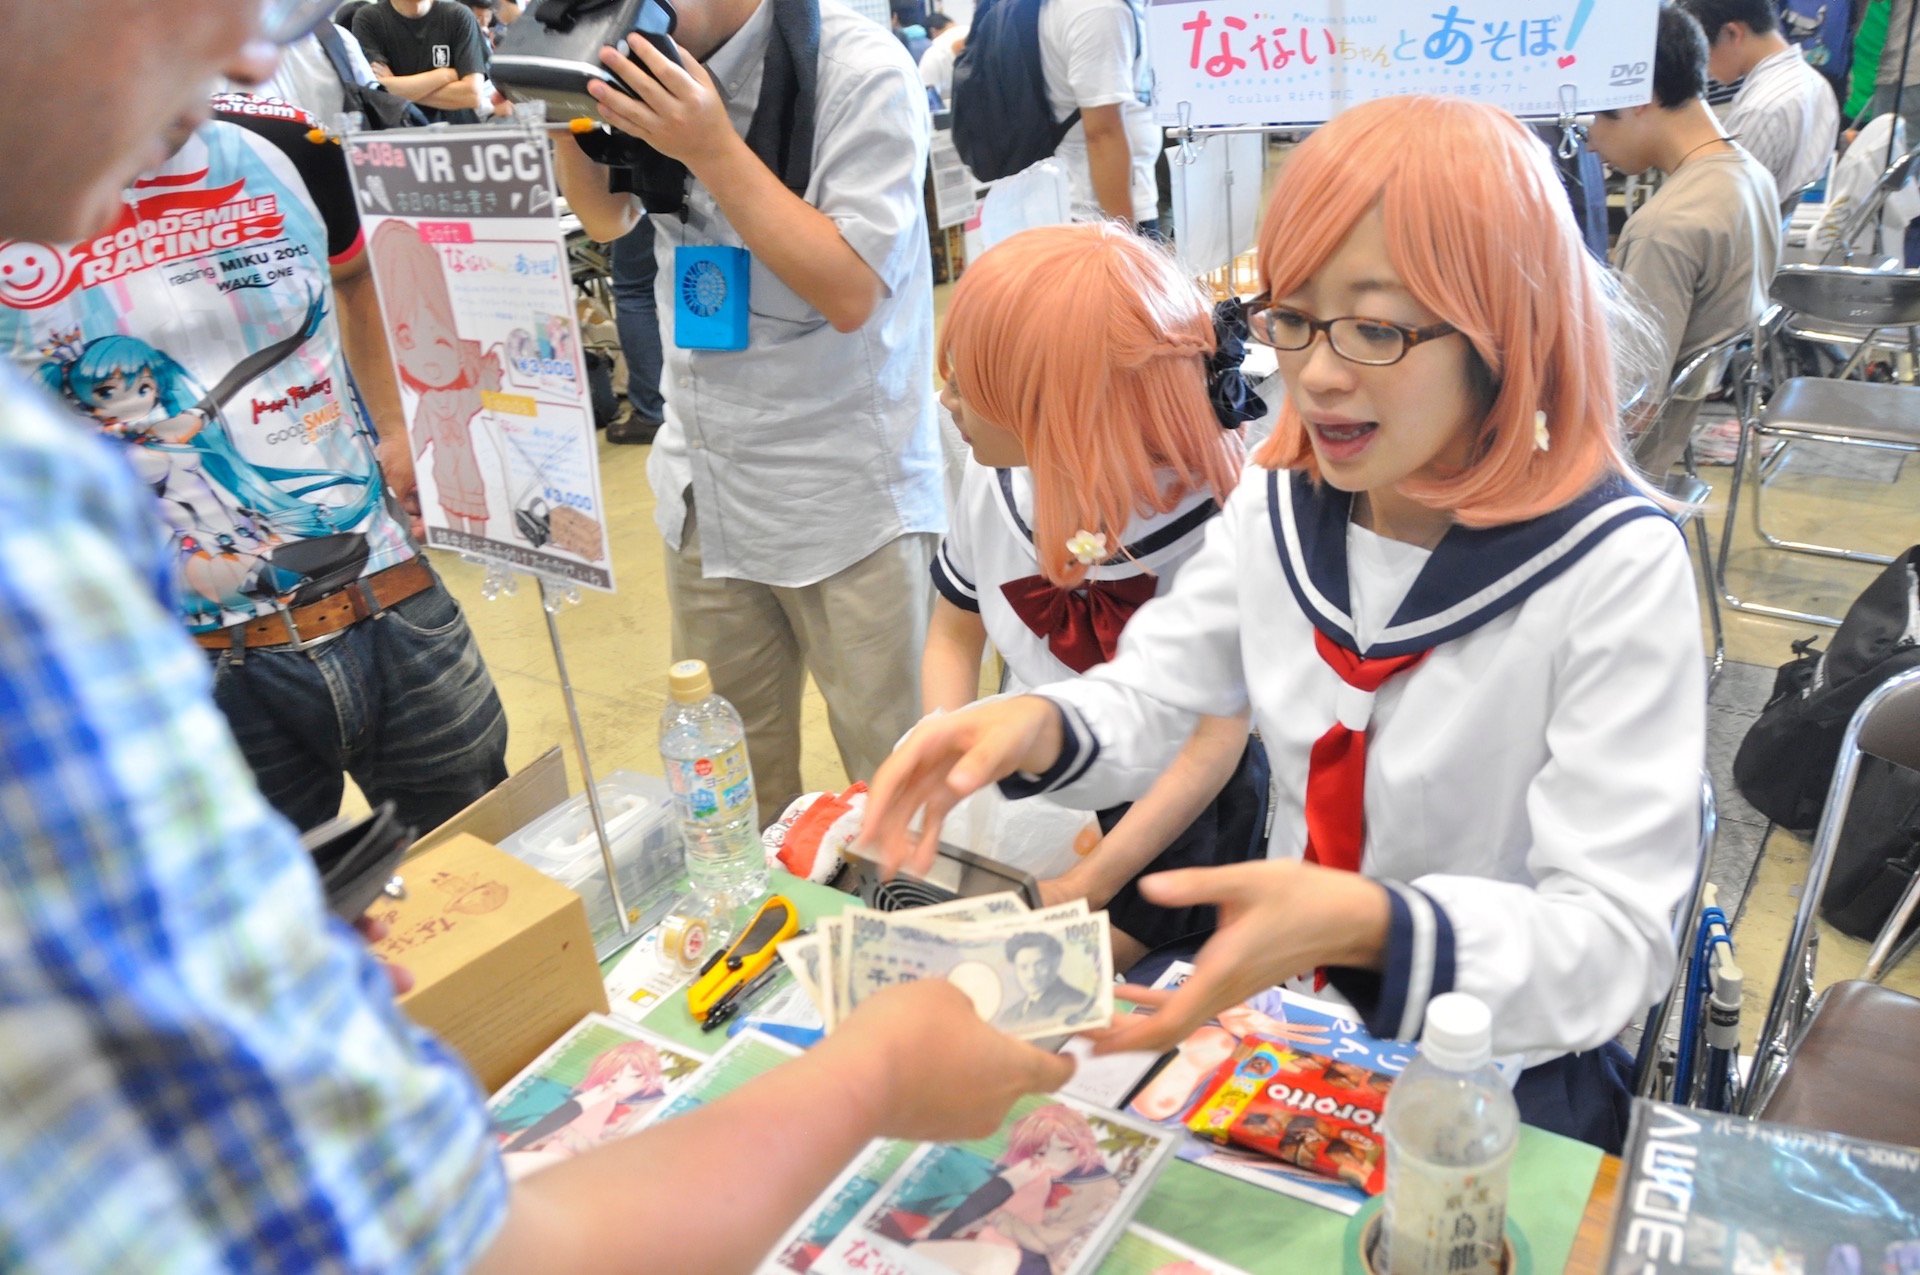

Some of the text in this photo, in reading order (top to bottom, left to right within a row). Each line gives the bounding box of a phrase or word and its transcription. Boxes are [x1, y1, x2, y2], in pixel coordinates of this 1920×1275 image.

[1610, 61, 1648, 79] DVD
[1228, 93, 1281, 105] Oculus
[406, 146, 456, 183] VR
[462, 142, 542, 182] JCC
[91, 194, 277, 257] GOODSMILE
[82, 223, 239, 290] RACING
[168, 244, 311, 287] racing MIKU 2013
[216, 267, 295, 294] WAVE ONE
[265, 400, 341, 445] GOOD SMILE
[1064, 920, 1100, 942] 1000
